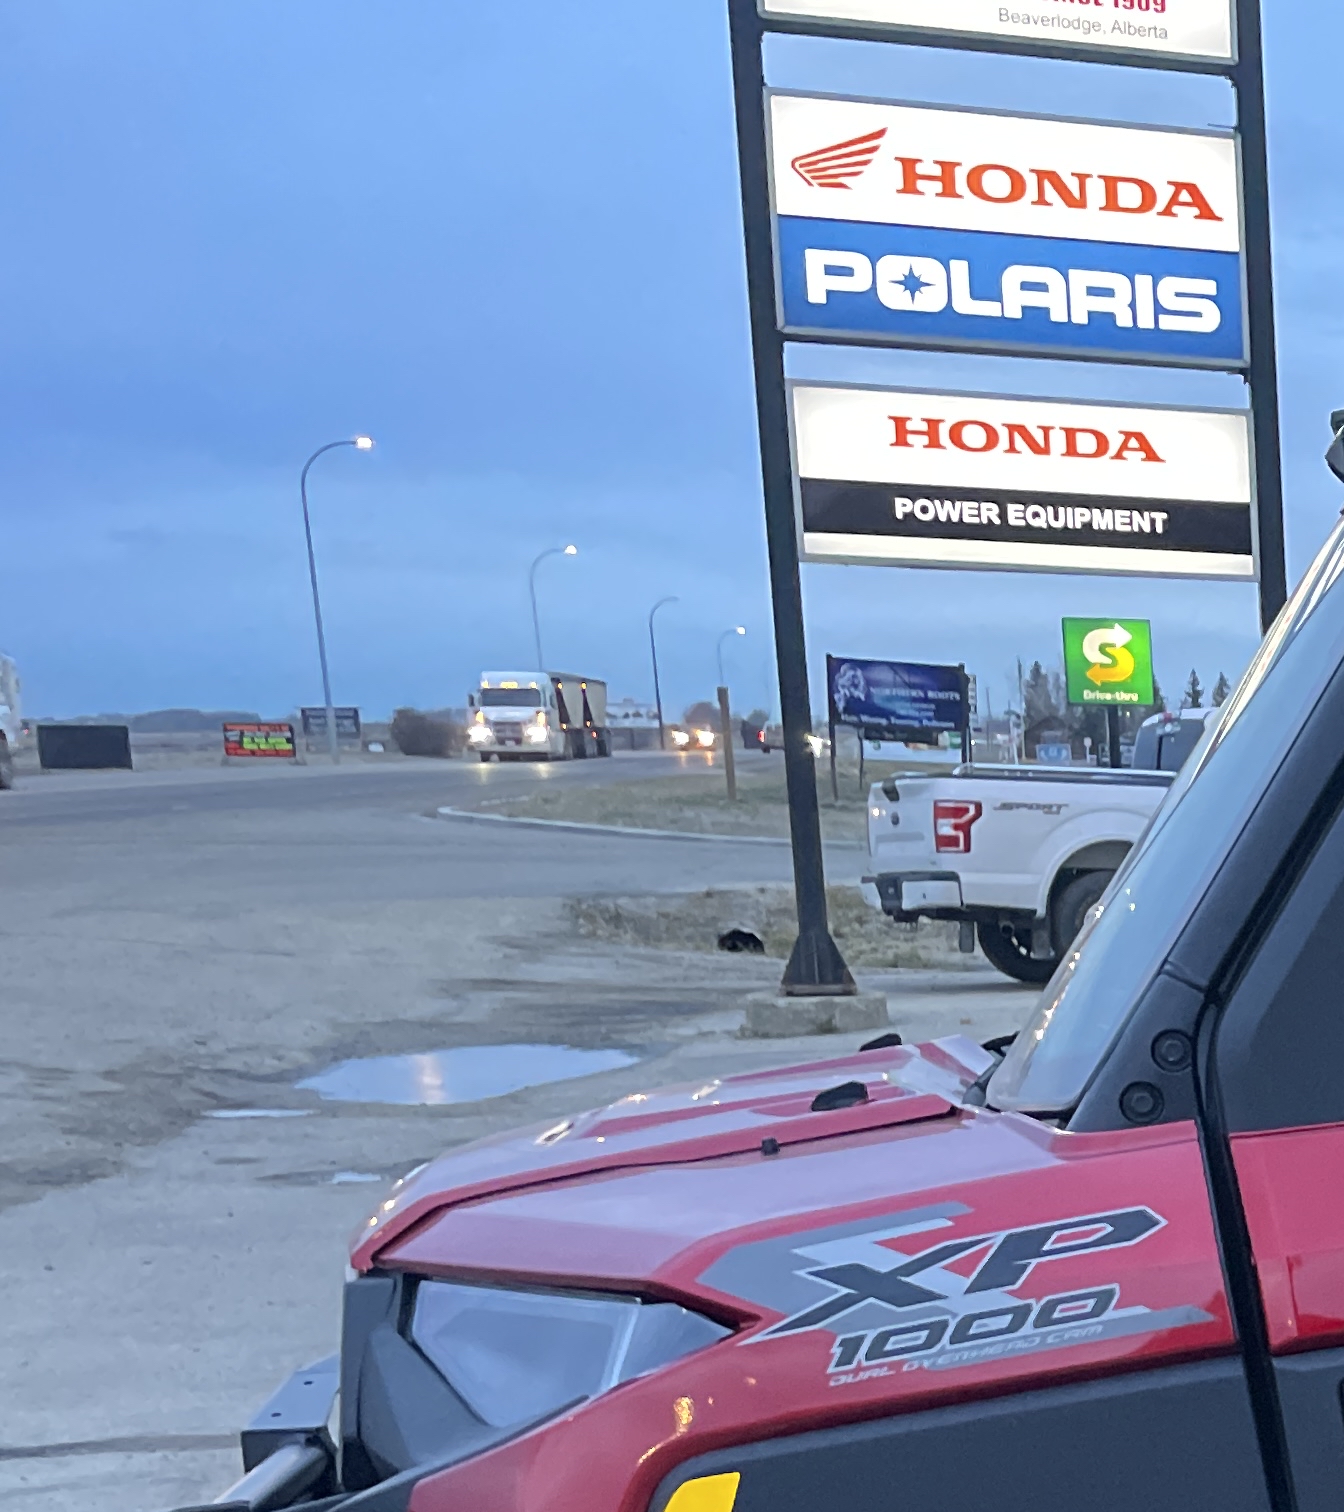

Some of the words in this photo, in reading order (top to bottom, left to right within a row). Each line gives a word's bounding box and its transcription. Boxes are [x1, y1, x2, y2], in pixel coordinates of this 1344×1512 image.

[998, 8, 1107, 35] Beaverlodge,
[1111, 20, 1168, 39] Alberta
[893, 157, 1223, 222] HONDA
[804, 248, 1222, 334] POLARIS
[887, 415, 1166, 464] HONDA
[894, 497, 1001, 525] POWER
[1007, 503, 1168, 535] EQUIPMENT
[1083, 689, 1138, 702] Drive-thru
[737, 1205, 1168, 1346] XP
[826, 1283, 1120, 1374] 1000
[829, 1366, 896, 1387] DUAL
[902, 1337, 1041, 1371] OVERHEAD
[1046, 1324, 1104, 1344] CAM
